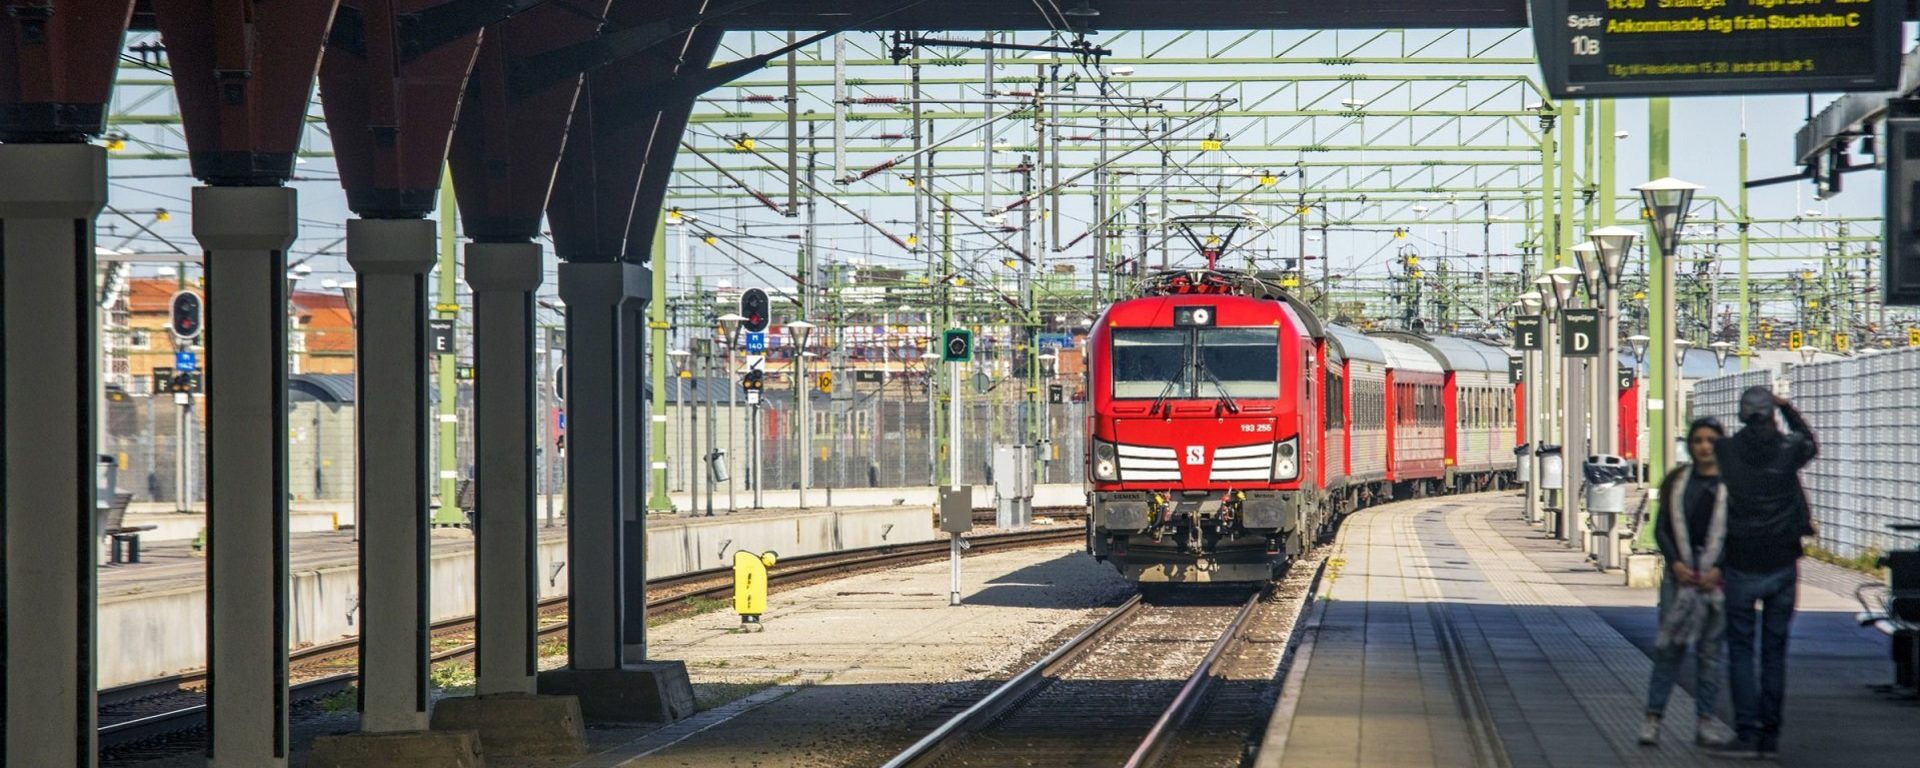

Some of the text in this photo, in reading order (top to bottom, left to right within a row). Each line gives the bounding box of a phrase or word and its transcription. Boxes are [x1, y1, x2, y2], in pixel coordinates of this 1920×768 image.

[1567, 14, 1603, 29] Spår
[1606, 12, 1861, 34] Ankommande tåg från Stockholm C
[1571, 35, 1600, 55] 10B
[437, 336, 446, 351] E
[748, 342, 763, 350] 140
[1524, 332, 1533, 346] E
[1574, 332, 1589, 351] D
[1516, 369, 1523, 380] F
[1621, 377, 1630, 387] G
